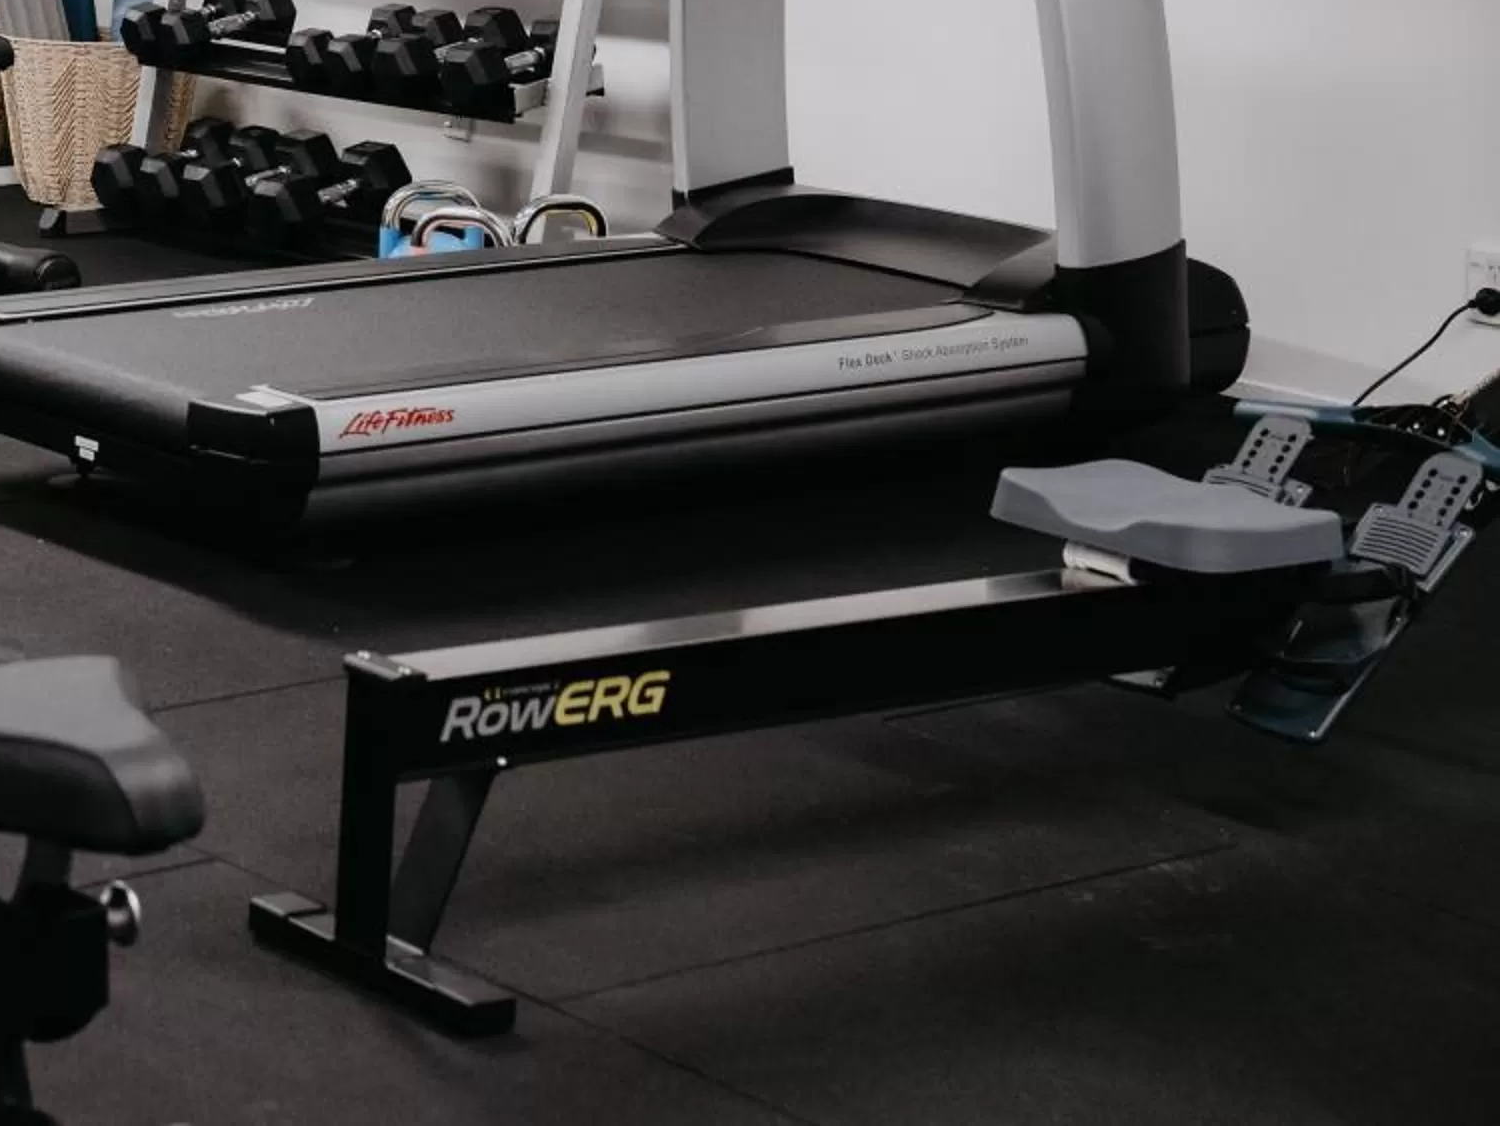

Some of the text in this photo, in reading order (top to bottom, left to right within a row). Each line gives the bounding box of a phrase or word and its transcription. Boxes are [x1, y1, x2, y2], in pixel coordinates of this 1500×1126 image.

[838, 356, 863, 371] Flex
[865, 349, 893, 366] Deck
[902, 346, 933, 361] Shock
